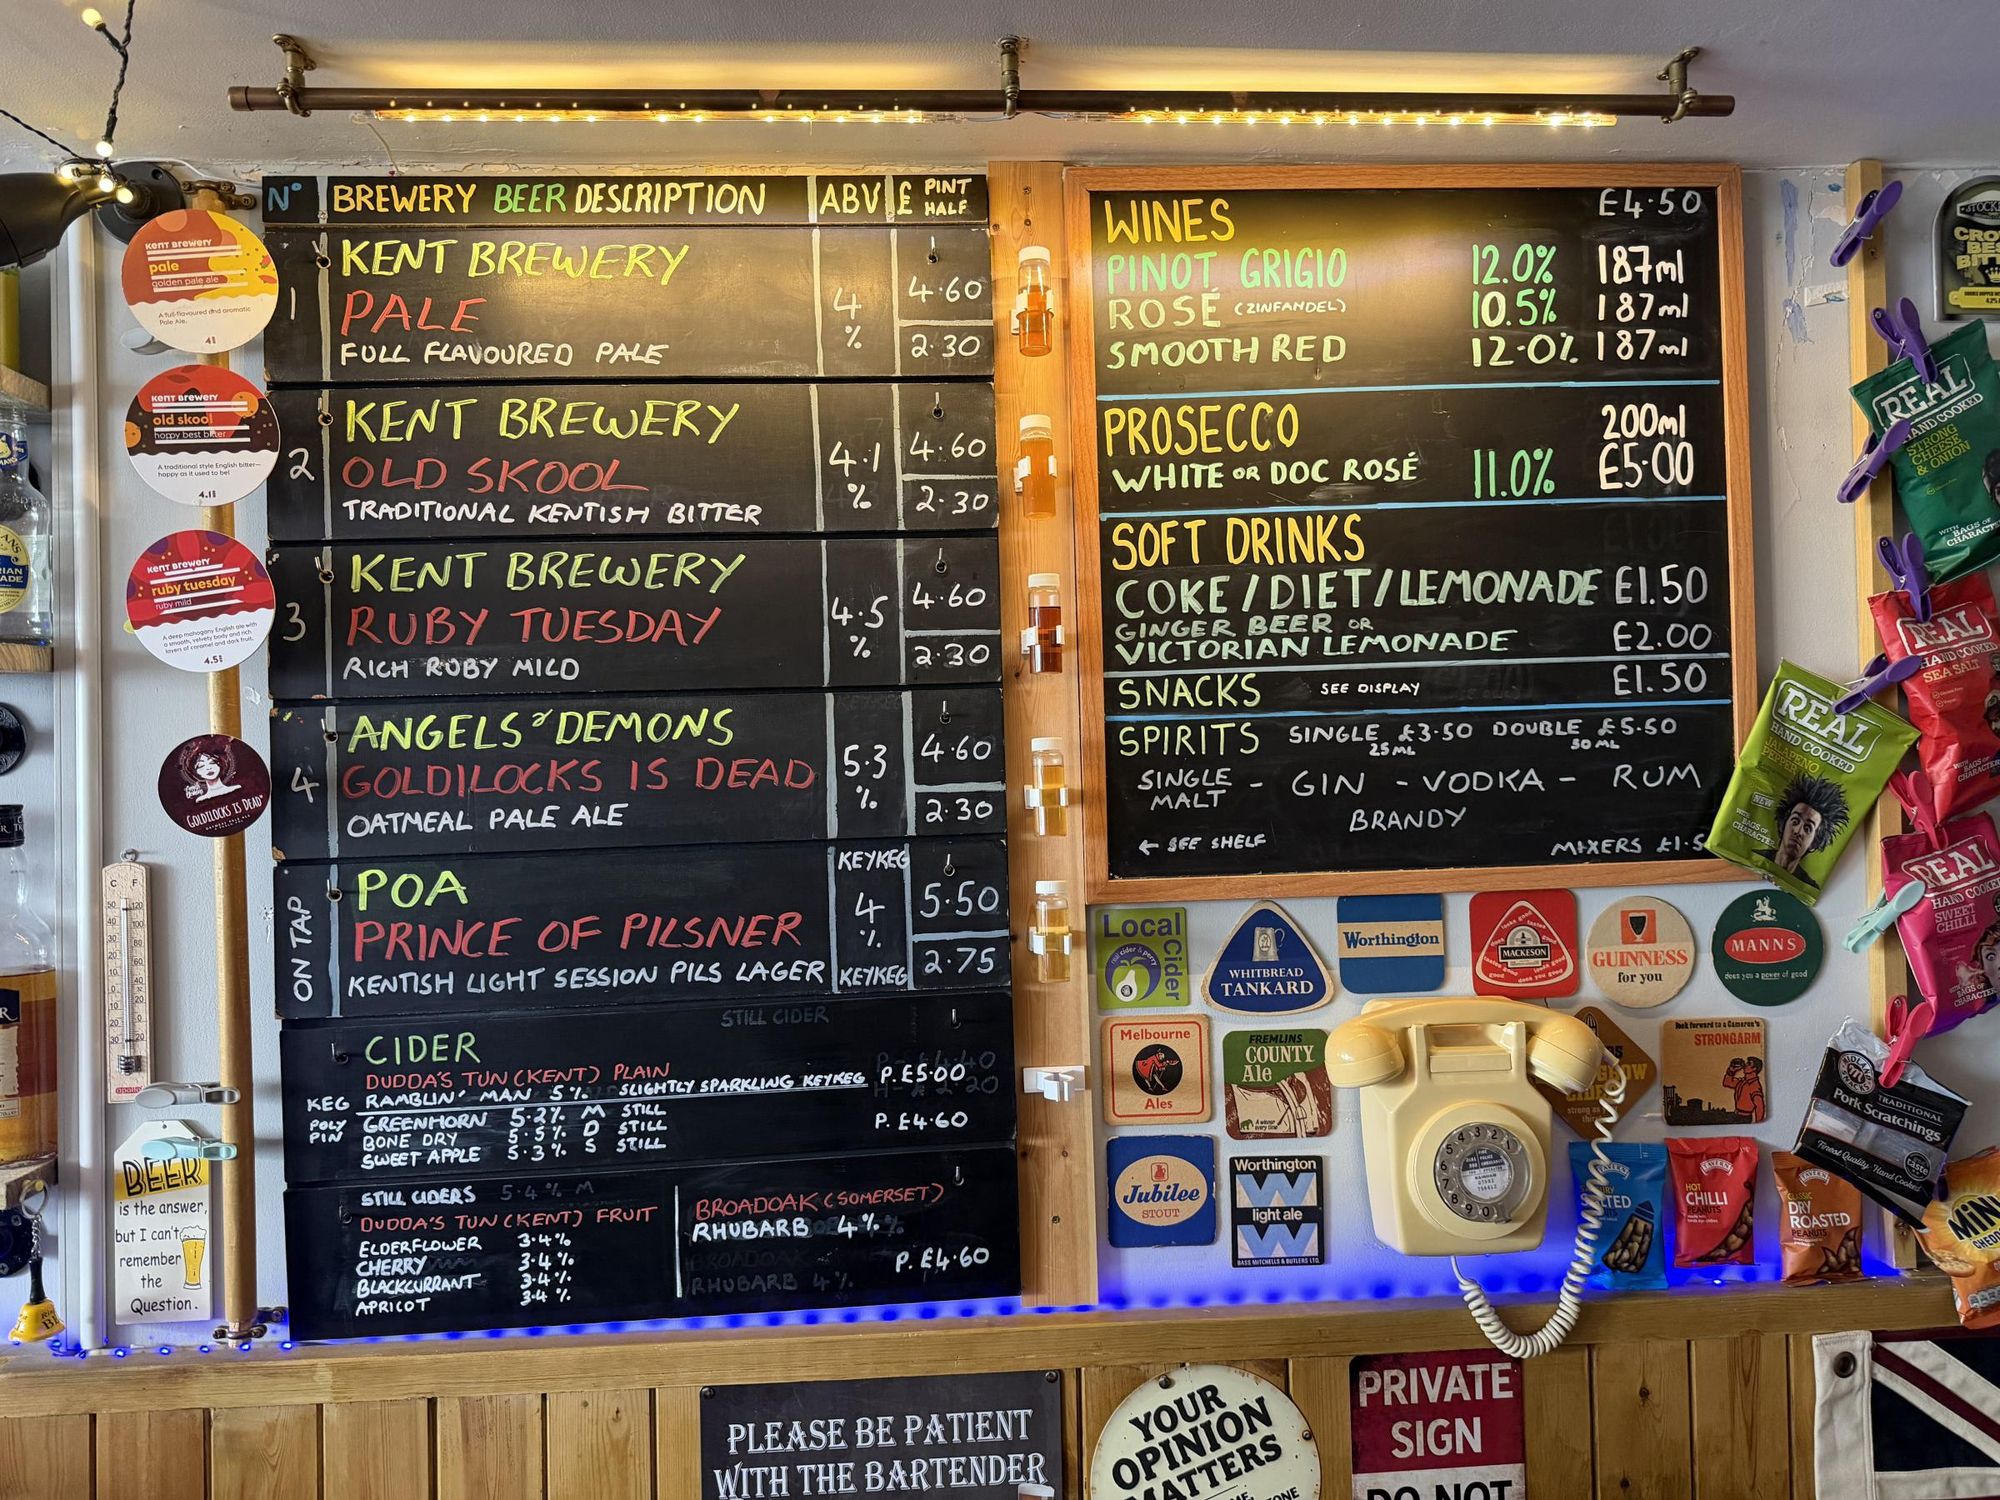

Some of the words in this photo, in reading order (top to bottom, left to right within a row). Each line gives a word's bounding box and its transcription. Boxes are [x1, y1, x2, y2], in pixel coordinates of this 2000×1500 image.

[333, 184, 474, 213] BREWERY
[495, 184, 565, 212] BEER
[575, 183, 765, 215] DESCRIPTION
[820, 184, 879, 212] ABV
[924, 179, 971, 196] PINT
[924, 200, 967, 216] HALF
[1104, 199, 1235, 244] WINES
[149, 261, 179, 275] pale
[342, 239, 457, 278] KENT
[468, 243, 689, 284] BREWERY
[1107, 249, 1217, 294] PINOT
[1240, 248, 1347, 289] GRIGIO
[1472, 244, 1556, 286] 12.0%
[1597, 244, 1685, 286] 187ml
[152, 277, 181, 287] golden
[185, 276, 203, 286] pale
[206, 275, 219, 283] ale
[342, 291, 486, 334] PALE
[1109, 288, 1221, 329] ROSÉ
[1472, 288, 1556, 328] 10.5%
[341, 342, 409, 365] FULL
[425, 341, 572, 366] FLAVOURED
[596, 343, 669, 365] PALE
[1108, 335, 1259, 369] SMOOTH
[1272, 334, 1346, 363] RED
[1880, 366, 1968, 424] REAL
[153, 414, 175, 425] old
[178, 413, 213, 425] skool
[346, 400, 476, 442] KENT
[498, 399, 740, 444] BREWERY
[1104, 402, 1299, 455] PROSECCO
[1601, 404, 1686, 440] 200ml
[1907, 423, 1958, 457] STRONG
[1911, 435, 1962, 466] CHEESE
[1930, 441, 1970, 469] ONION
[342, 457, 446, 490] OLD
[468, 459, 648, 492] SKOOL
[1112, 463, 1225, 493] WHITE
[1271, 458, 1330, 485] DOC
[1343, 451, 1419, 482] ROSÉ
[1473, 447, 1555, 500] 11.0%
[343, 500, 514, 523] TRADITIONAL
[529, 500, 649, 524] KENTISH
[667, 501, 762, 524] BITTER
[1112, 518, 1206, 571] SOFT
[1226, 513, 1365, 565] DRINKS
[352, 552, 486, 592] KENT
[506, 553, 746, 594] BREWERY
[152, 582, 181, 596] ruby
[184, 576, 235, 592] tuesday
[156, 600, 173, 610] ruby
[175, 598, 192, 607] mild
[347, 606, 489, 646] RUBY
[510, 607, 722, 645] TUESDAY
[1116, 614, 1233, 640] GINGER
[1248, 614, 1333, 634] BEER
[1906, 611, 1984, 649] REAL
[1116, 637, 1310, 663] VICTORIAN
[1323, 629, 1518, 656] LEMONADE
[344, 656, 409, 680] RICH
[425, 658, 498, 680] RUBY
[513, 656, 580, 680] MILD
[1923, 668, 1952, 683] SEA
[1955, 659, 1980, 675] SALT
[1119, 672, 1261, 709] SNACKS
[1320, 682, 1350, 695] SEE
[1357, 682, 1420, 696] DISPLAY
[347, 713, 521, 753] ANGELS
[556, 708, 735, 745] DEMONS
[1776, 688, 1868, 755] REAL
[1120, 722, 1260, 756] SPIRITS
[1771, 721, 1801, 746] HAND
[1803, 742, 1856, 774] COOKED
[343, 759, 602, 797] GOLDILOCKS
[632, 759, 669, 790] IS
[695, 759, 814, 789] DEAD
[1292, 771, 1365, 796] GIN
[1421, 768, 1545, 795] VODKA
[1613, 763, 1702, 789] RUM
[347, 809, 471, 838] OATMEAL
[489, 806, 562, 830] PALE
[571, 803, 628, 827] ALE
[1350, 807, 1466, 833] BRANDY
[837, 848, 910, 871] KEYKEG
[358, 868, 468, 910] POA
[1104, 913, 1181, 938] Local
[1935, 904, 1975, 923] SWEET
[1936, 915, 1977, 933] CHILLI
[354, 916, 522, 962] PRINCE
[538, 916, 600, 952] OF
[624, 910, 802, 950] PILSNER
[1343, 931, 1439, 948] Worthington
[1732, 938, 1797, 952] MANNS
[1503, 948, 1547, 958] MACKESON
[1593, 950, 1688, 968] GUINNESS
[348, 972, 455, 997] KENTISH
[467, 968, 545, 993] LIGHT
[555, 968, 664, 990] SESSION
[670, 962, 726, 986] PILS
[736, 959, 825, 984] LAGER
[1163, 939, 1182, 1000] Cider
[1229, 968, 1303, 978] WHITBREAD
[1617, 972, 1635, 983] for
[1640, 973, 1662, 984] you
[1791, 970, 1808, 980] good
[1221, 982, 1313, 996] TANKARD
[1121, 1028, 1190, 1040] Melbourne
[1249, 1034, 1302, 1043] FREMLINS
[1694, 1033, 1760, 1045] STRONGARM
[365, 1033, 481, 1065] CIDER
[1246, 1046, 1315, 1063] COUNTY
[465, 1070, 508, 1088] TUN
[614, 1063, 670, 1080] PLAIN
[1242, 1065, 1272, 1082] Ale
[1144, 1099, 1173, 1110] Ales
[1833, 1088, 1862, 1112] Pork
[1864, 1103, 1941, 1141] Scratchings
[1878, 1095, 1944, 1123] TRADITIONAL
[122, 1157, 202, 1196] BEER
[1235, 1159, 1316, 1173] Worthington
[695, 1194, 818, 1220] BROADOAK
[1123, 1186, 1200, 1203] Jubilee
[1686, 1192, 1728, 1206] CHILLI
[119, 1202, 129, 1215] is
[134, 1201, 155, 1215] the
[159, 1202, 207, 1215] answer,
[1142, 1209, 1179, 1218] STOUT
[1252, 1208, 1280, 1223] light
[1283, 1209, 1302, 1220] ale
[1687, 1206, 1721, 1214] PEANUTS
[1789, 1202, 1811, 1216] DRY
[1790, 1213, 1850, 1228] ROASTED
[116, 1229, 135, 1242] but
[140, 1229, 146, 1241] I
[693, 1217, 809, 1241] RHUBARB
[1791, 1229, 1827, 1238] PEANUTS
[359, 1235, 482, 1255] ELDERFLOWER
[120, 1253, 181, 1267] remember
[356, 1255, 426, 1275] CHERRY
[141, 1274, 162, 1287] the
[357, 1274, 481, 1297] BLACKCURRANT
[355, 1299, 430, 1315] APRICOT
[1359, 1364, 1514, 1407] PRIVATE
[1129, 1384, 1226, 1442] YOUR
[728, 1418, 848, 1454] PLEASE
[856, 1416, 896, 1448] BE
[904, 1409, 1034, 1445] PATIENT
[1112, 1396, 1274, 1489] OPINION
[1390, 1417, 1482, 1458] SIGN
[713, 1461, 790, 1499] WITH
[797, 1462, 856, 1495] THE
[864, 1452, 1049, 1491] BARTENDER
[1123, 1434, 1282, 1500] MATTERS
